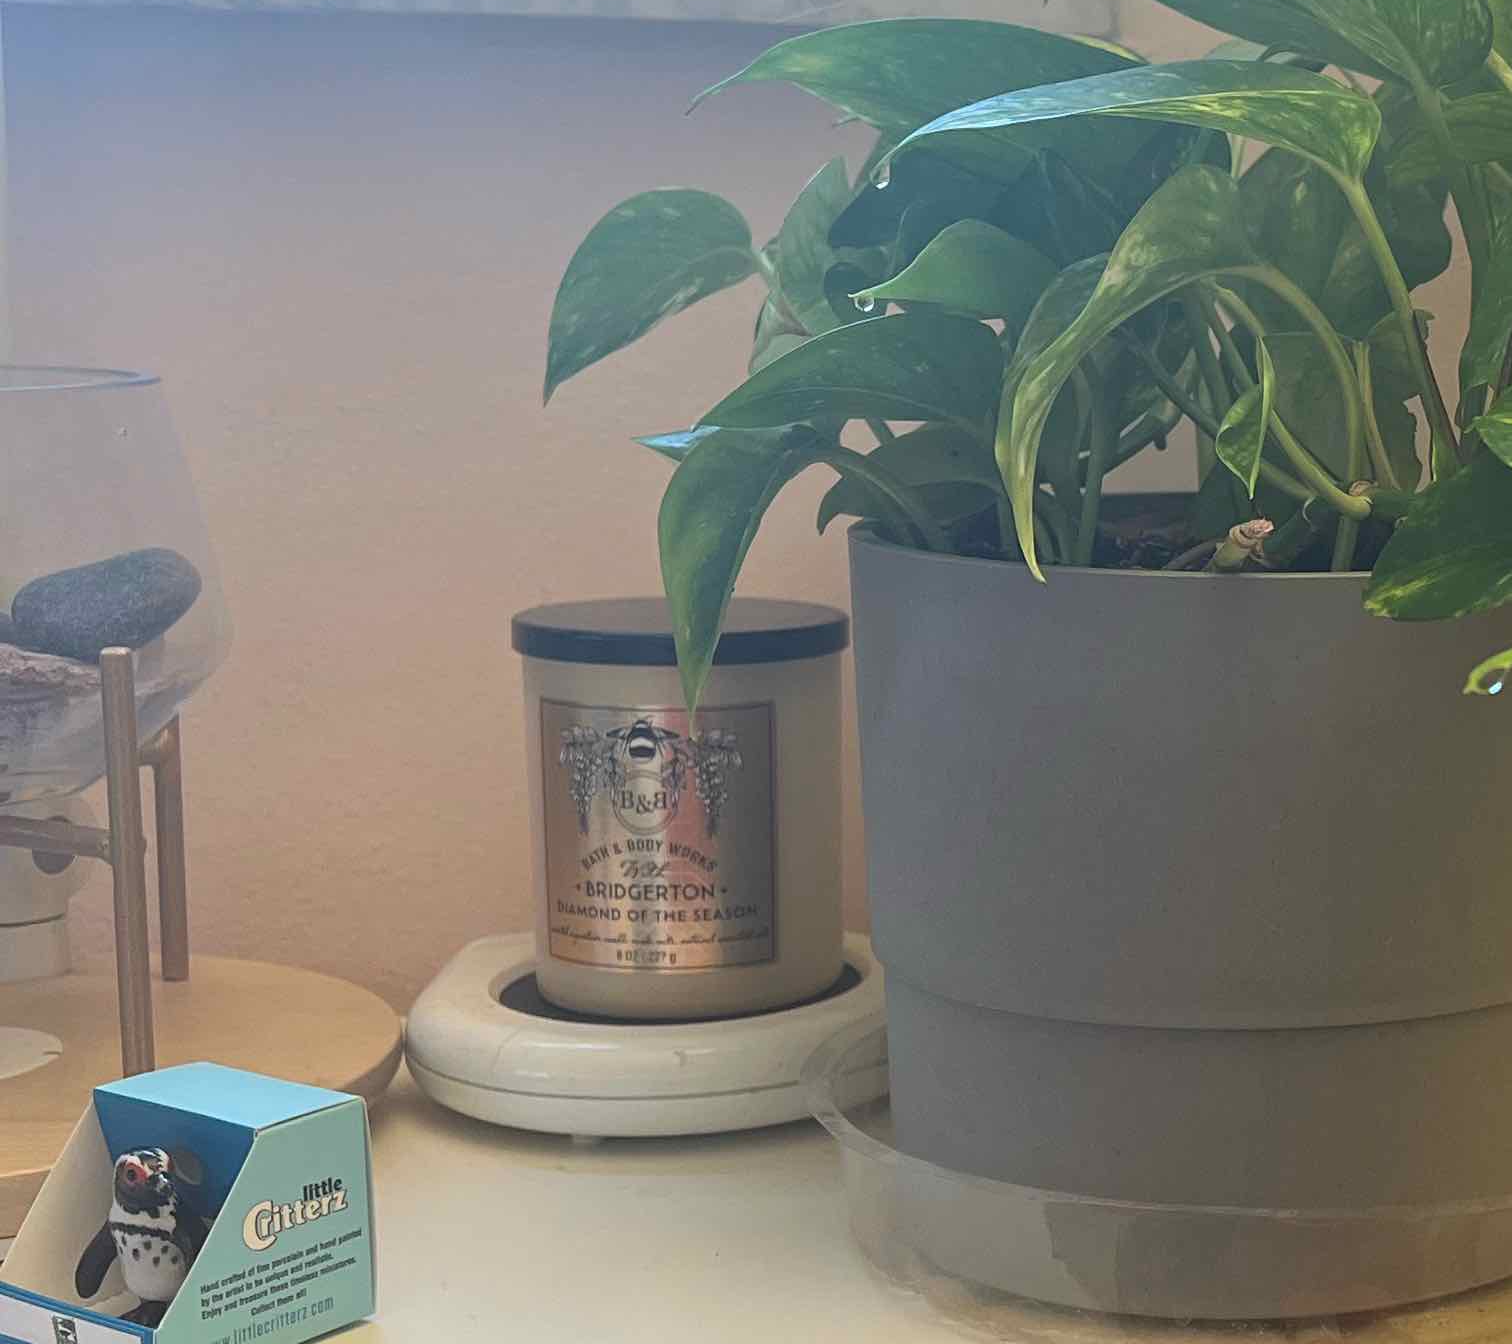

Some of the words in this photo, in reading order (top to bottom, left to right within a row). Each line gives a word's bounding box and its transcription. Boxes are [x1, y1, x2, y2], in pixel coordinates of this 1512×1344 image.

[586, 882, 715, 902] BRIDGERTON
[557, 899, 622, 922] DIAMOND
[627, 909, 648, 923] OF
[656, 909, 687, 923] THE
[693, 904, 760, 923] SEASON
[302, 1177, 343, 1202] little
[243, 1189, 348, 1252] Critterz
[201, 1306, 222, 1320] Enjoy
